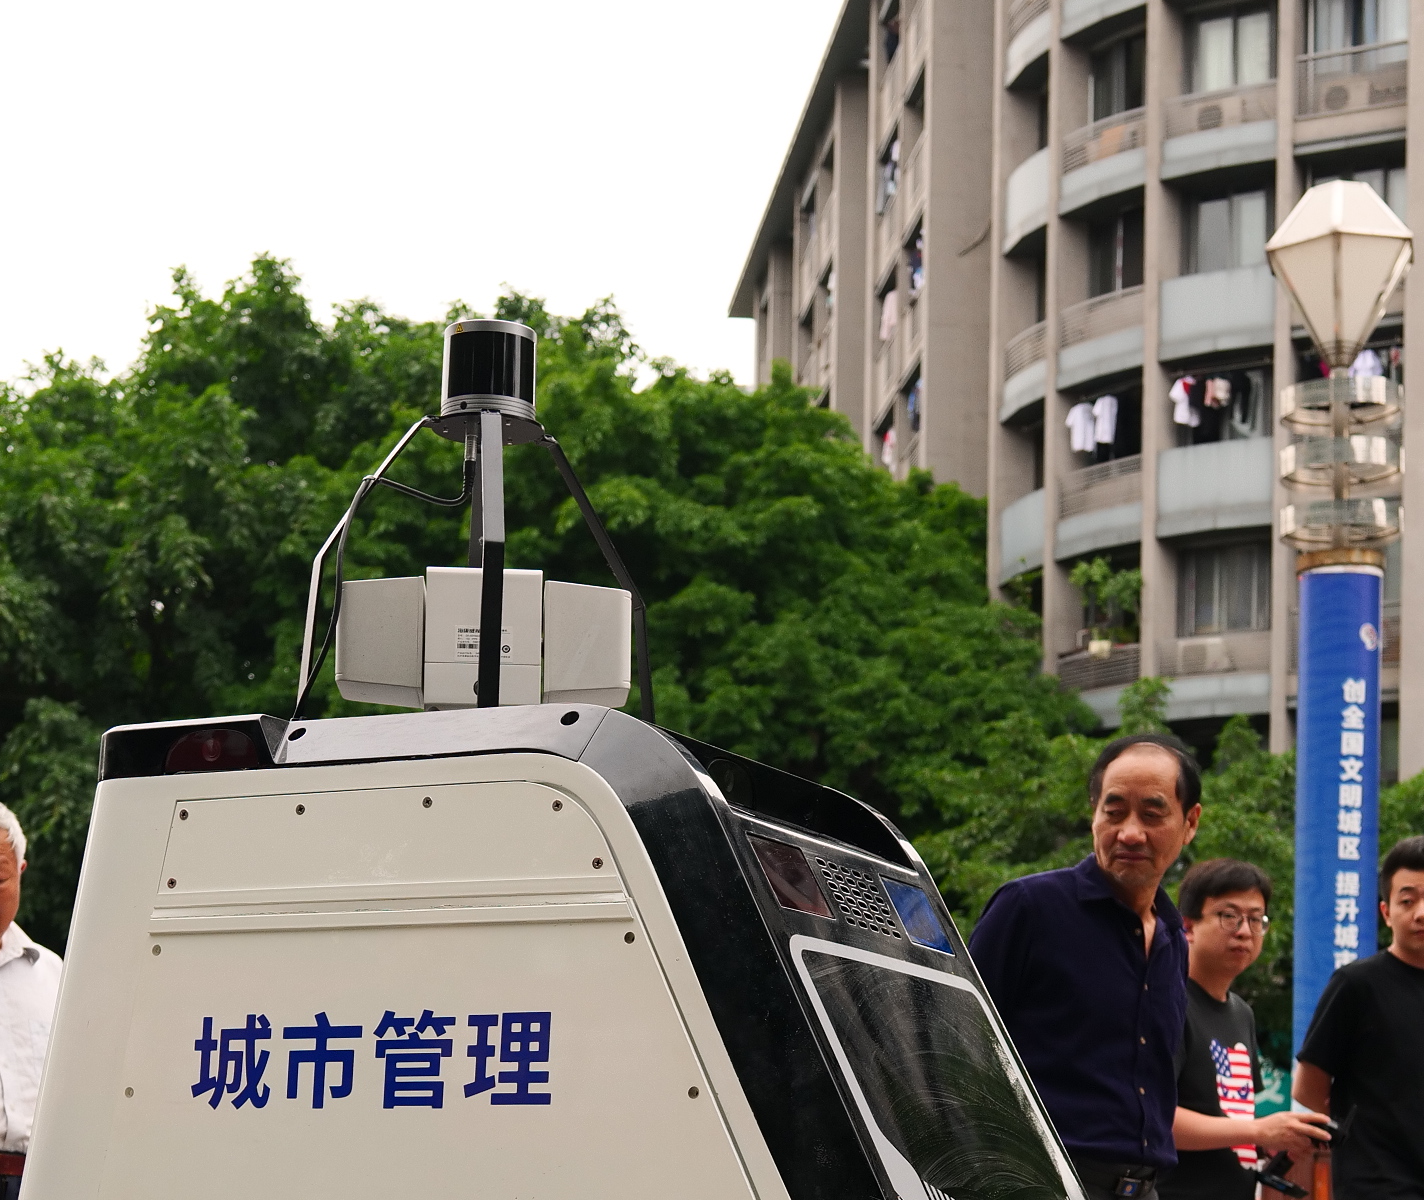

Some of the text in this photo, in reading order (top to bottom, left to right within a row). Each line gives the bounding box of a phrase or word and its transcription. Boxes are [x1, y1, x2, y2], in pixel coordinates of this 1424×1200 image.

[1337, 678, 1366, 861] 创全国文明城区
[190, 1009, 552, 1110] 城市管理
